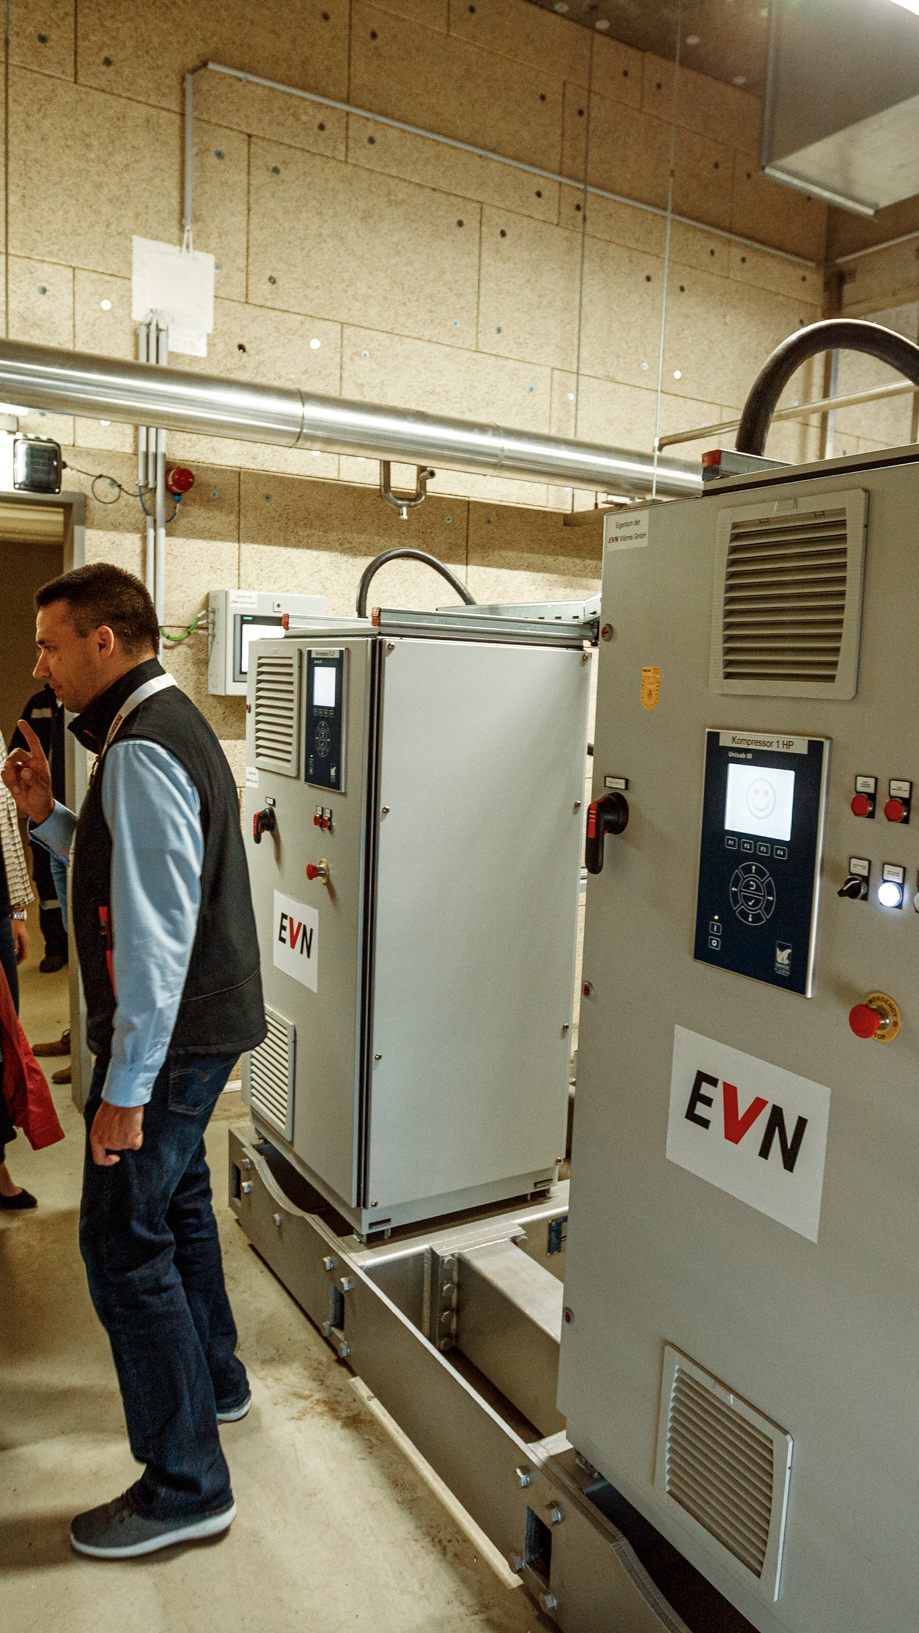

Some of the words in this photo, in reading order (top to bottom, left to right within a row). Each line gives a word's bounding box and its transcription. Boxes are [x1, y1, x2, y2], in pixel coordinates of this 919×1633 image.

[731, 735, 774, 748] Kompressor
[782, 740, 794, 749] HP
[278, 912, 314, 960] EVN
[685, 1069, 808, 1174] EVN
